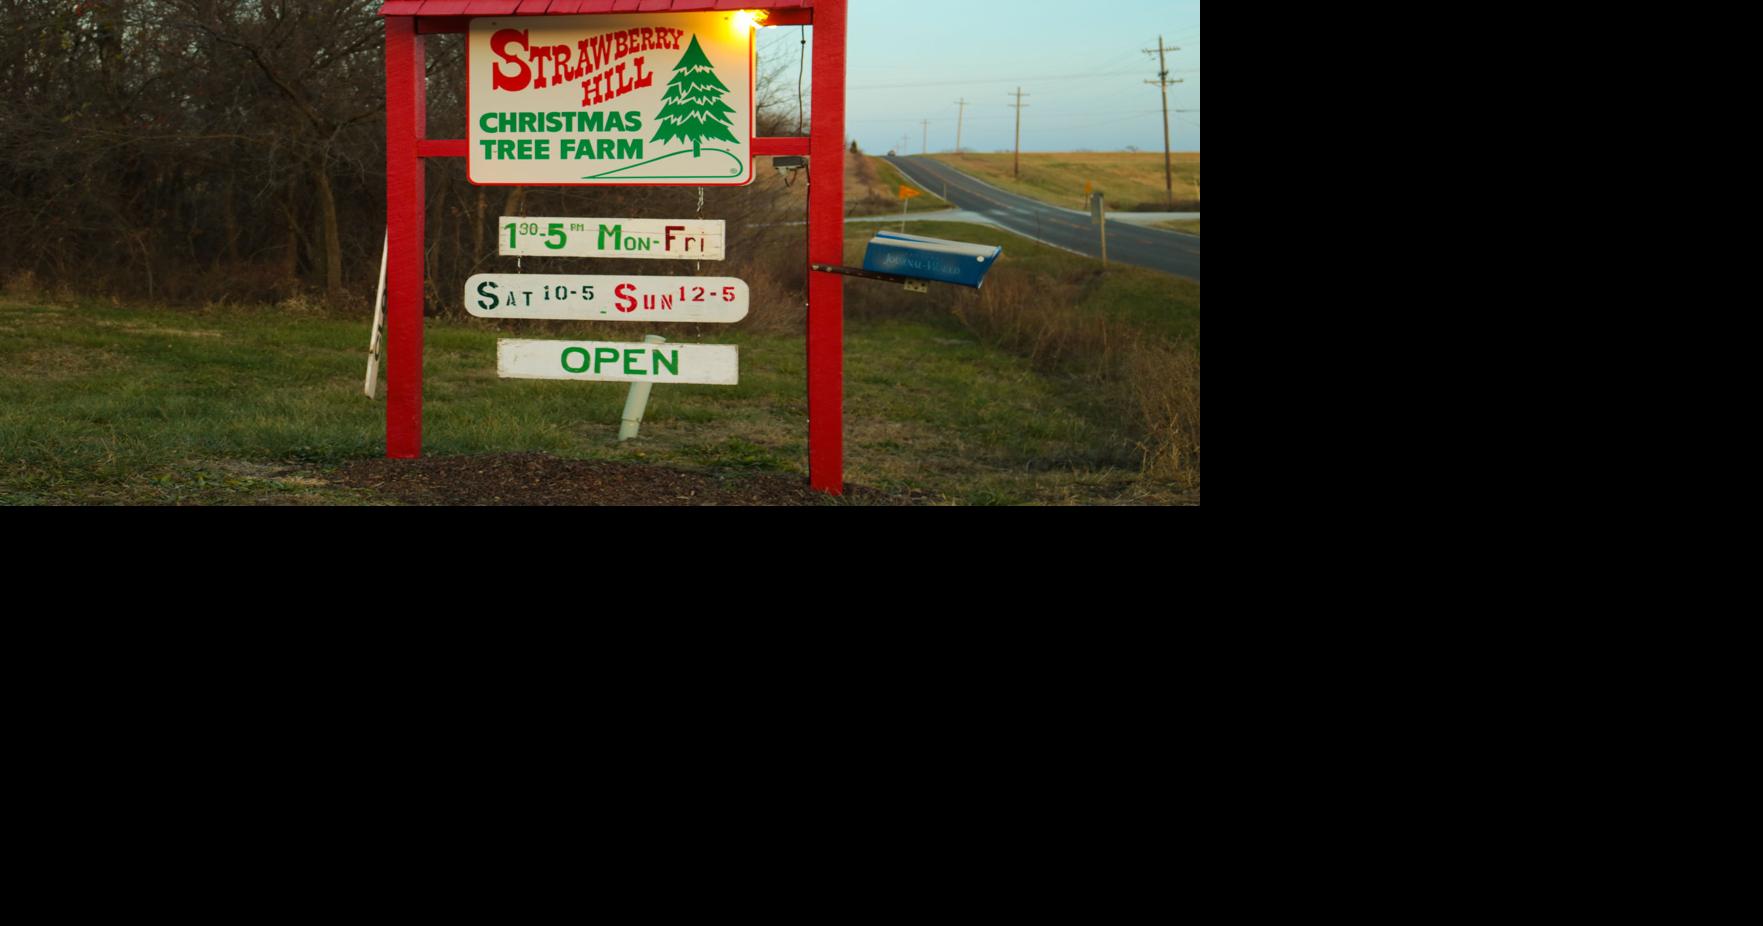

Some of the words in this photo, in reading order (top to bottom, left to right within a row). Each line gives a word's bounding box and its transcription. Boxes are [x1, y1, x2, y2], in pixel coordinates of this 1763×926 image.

[490, 26, 683, 92] STRAWBERRY
[581, 56, 653, 107] HILL
[479, 111, 641, 133] CHRISTMAS
[480, 139, 549, 160] TREE
[560, 138, 643, 160] FARM
[561, 346, 679, 375] OPEN
